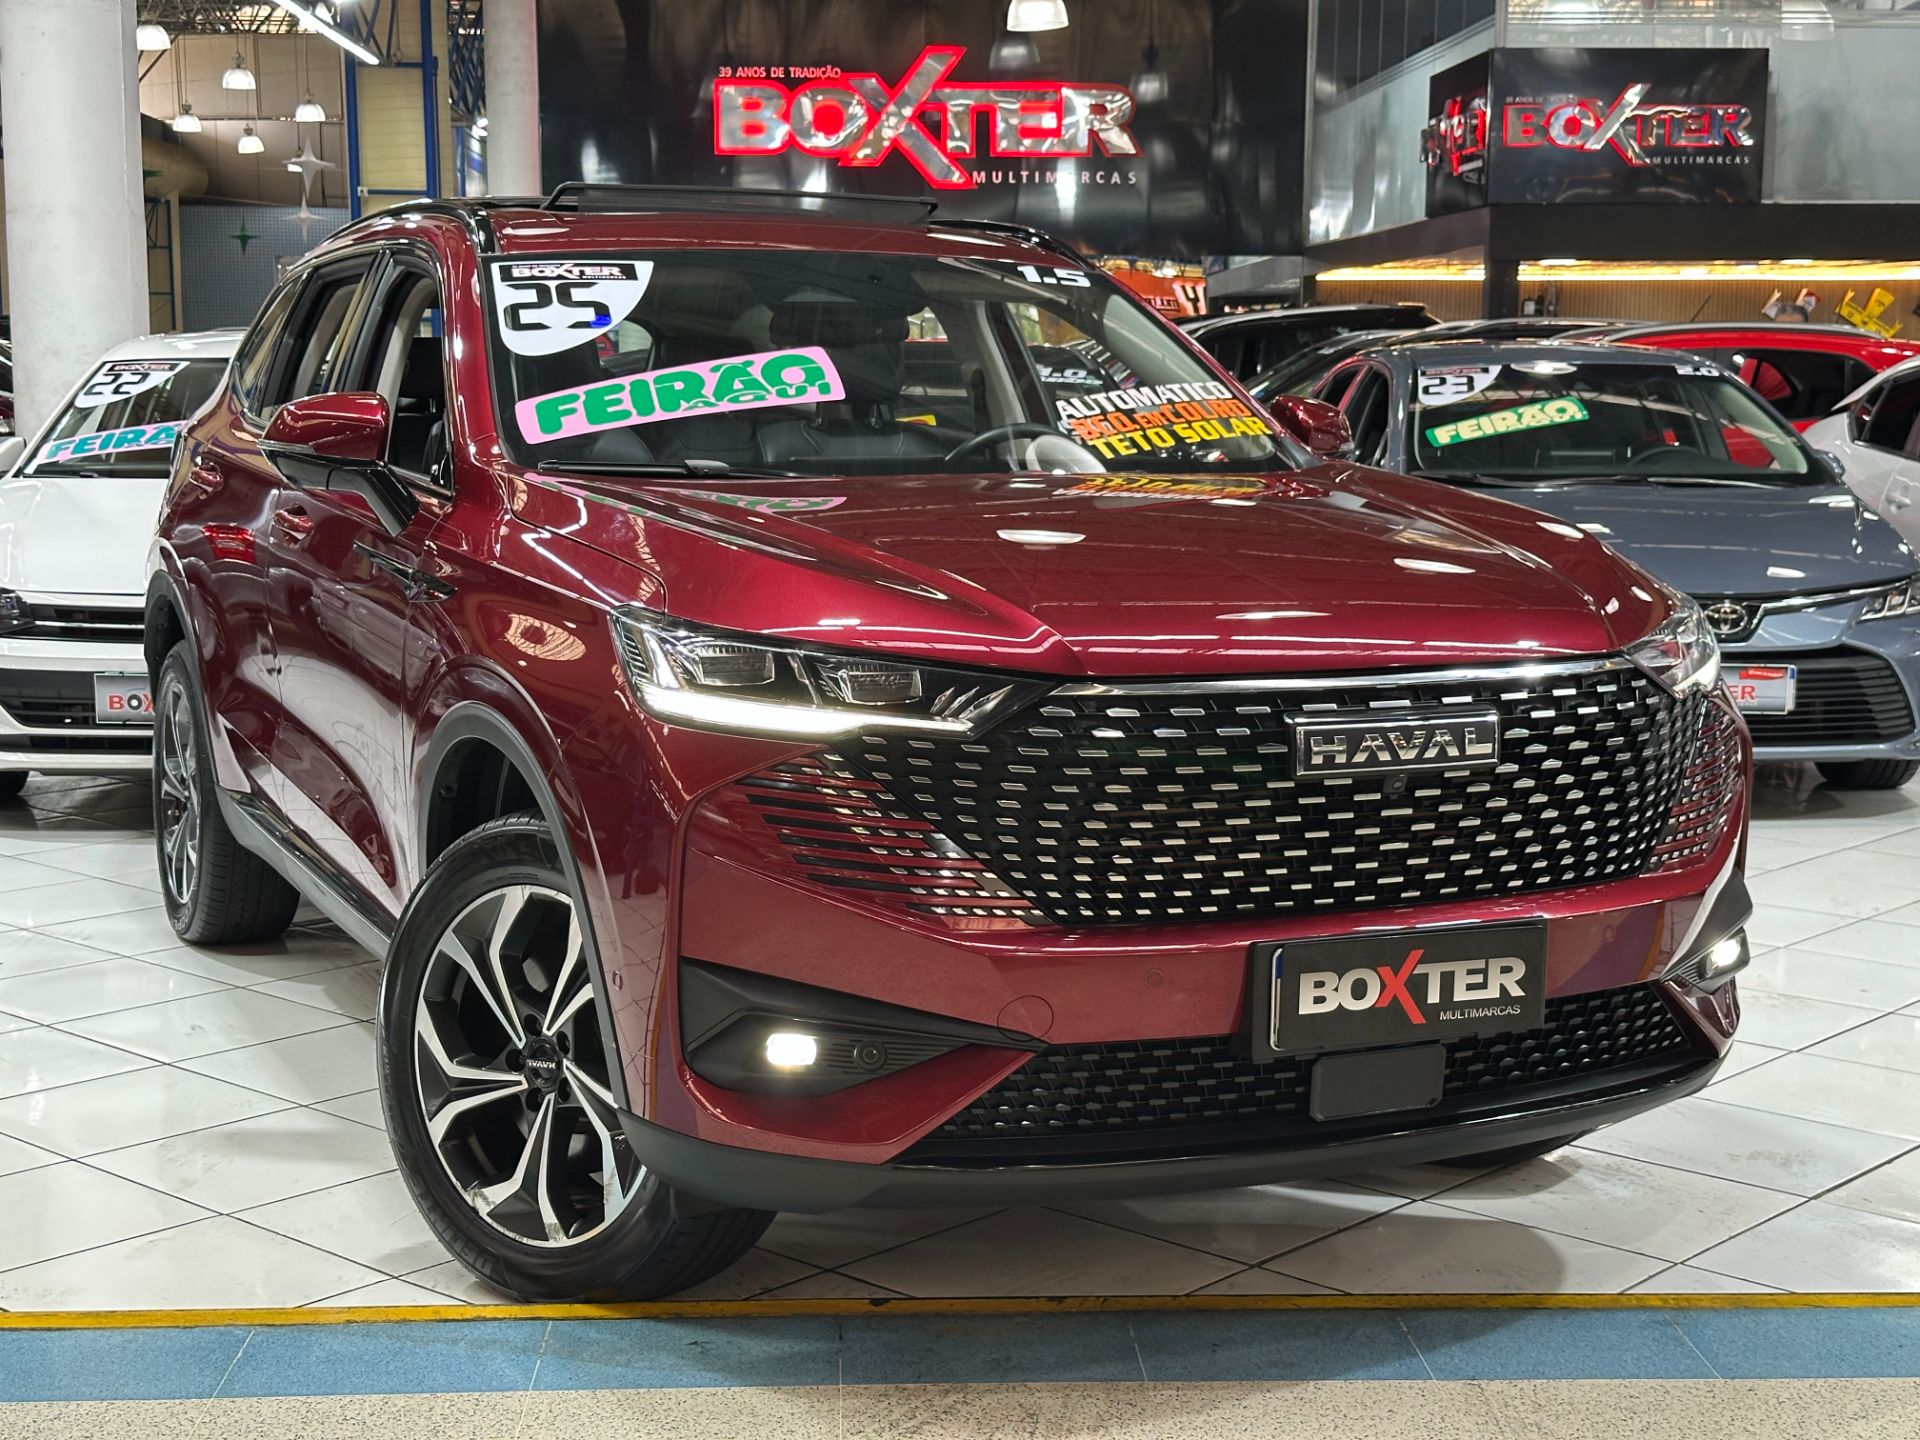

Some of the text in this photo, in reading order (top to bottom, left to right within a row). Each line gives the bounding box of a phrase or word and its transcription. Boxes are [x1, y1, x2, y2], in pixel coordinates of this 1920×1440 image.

[719, 65, 841, 80] 39 ANOS DE TRADIÇÃO
[714, 45, 1143, 189] BOXTER
[1503, 83, 1753, 167] BOXTER
[1652, 155, 1750, 165] MULTIMARCAS
[972, 171, 1137, 184] MULTIMRCAS
[511, 262, 622, 279] BOXTER
[1017, 265, 1091, 288] 1.5
[503, 282, 612, 331] 25
[83, 372, 151, 396] 22
[535, 354, 826, 435] FEIRÃO
[1422, 375, 1475, 395] 23
[1160, 399, 1252, 423] COURO
[1434, 399, 1580, 444] FEIRÃO
[1087, 416, 1273, 459] TETO SOLAR
[1310, 728, 1492, 765] HAVAL
[1299, 949, 1526, 1024] BOXTER
[1439, 1004, 1521, 1021] MULTIMARCAS
